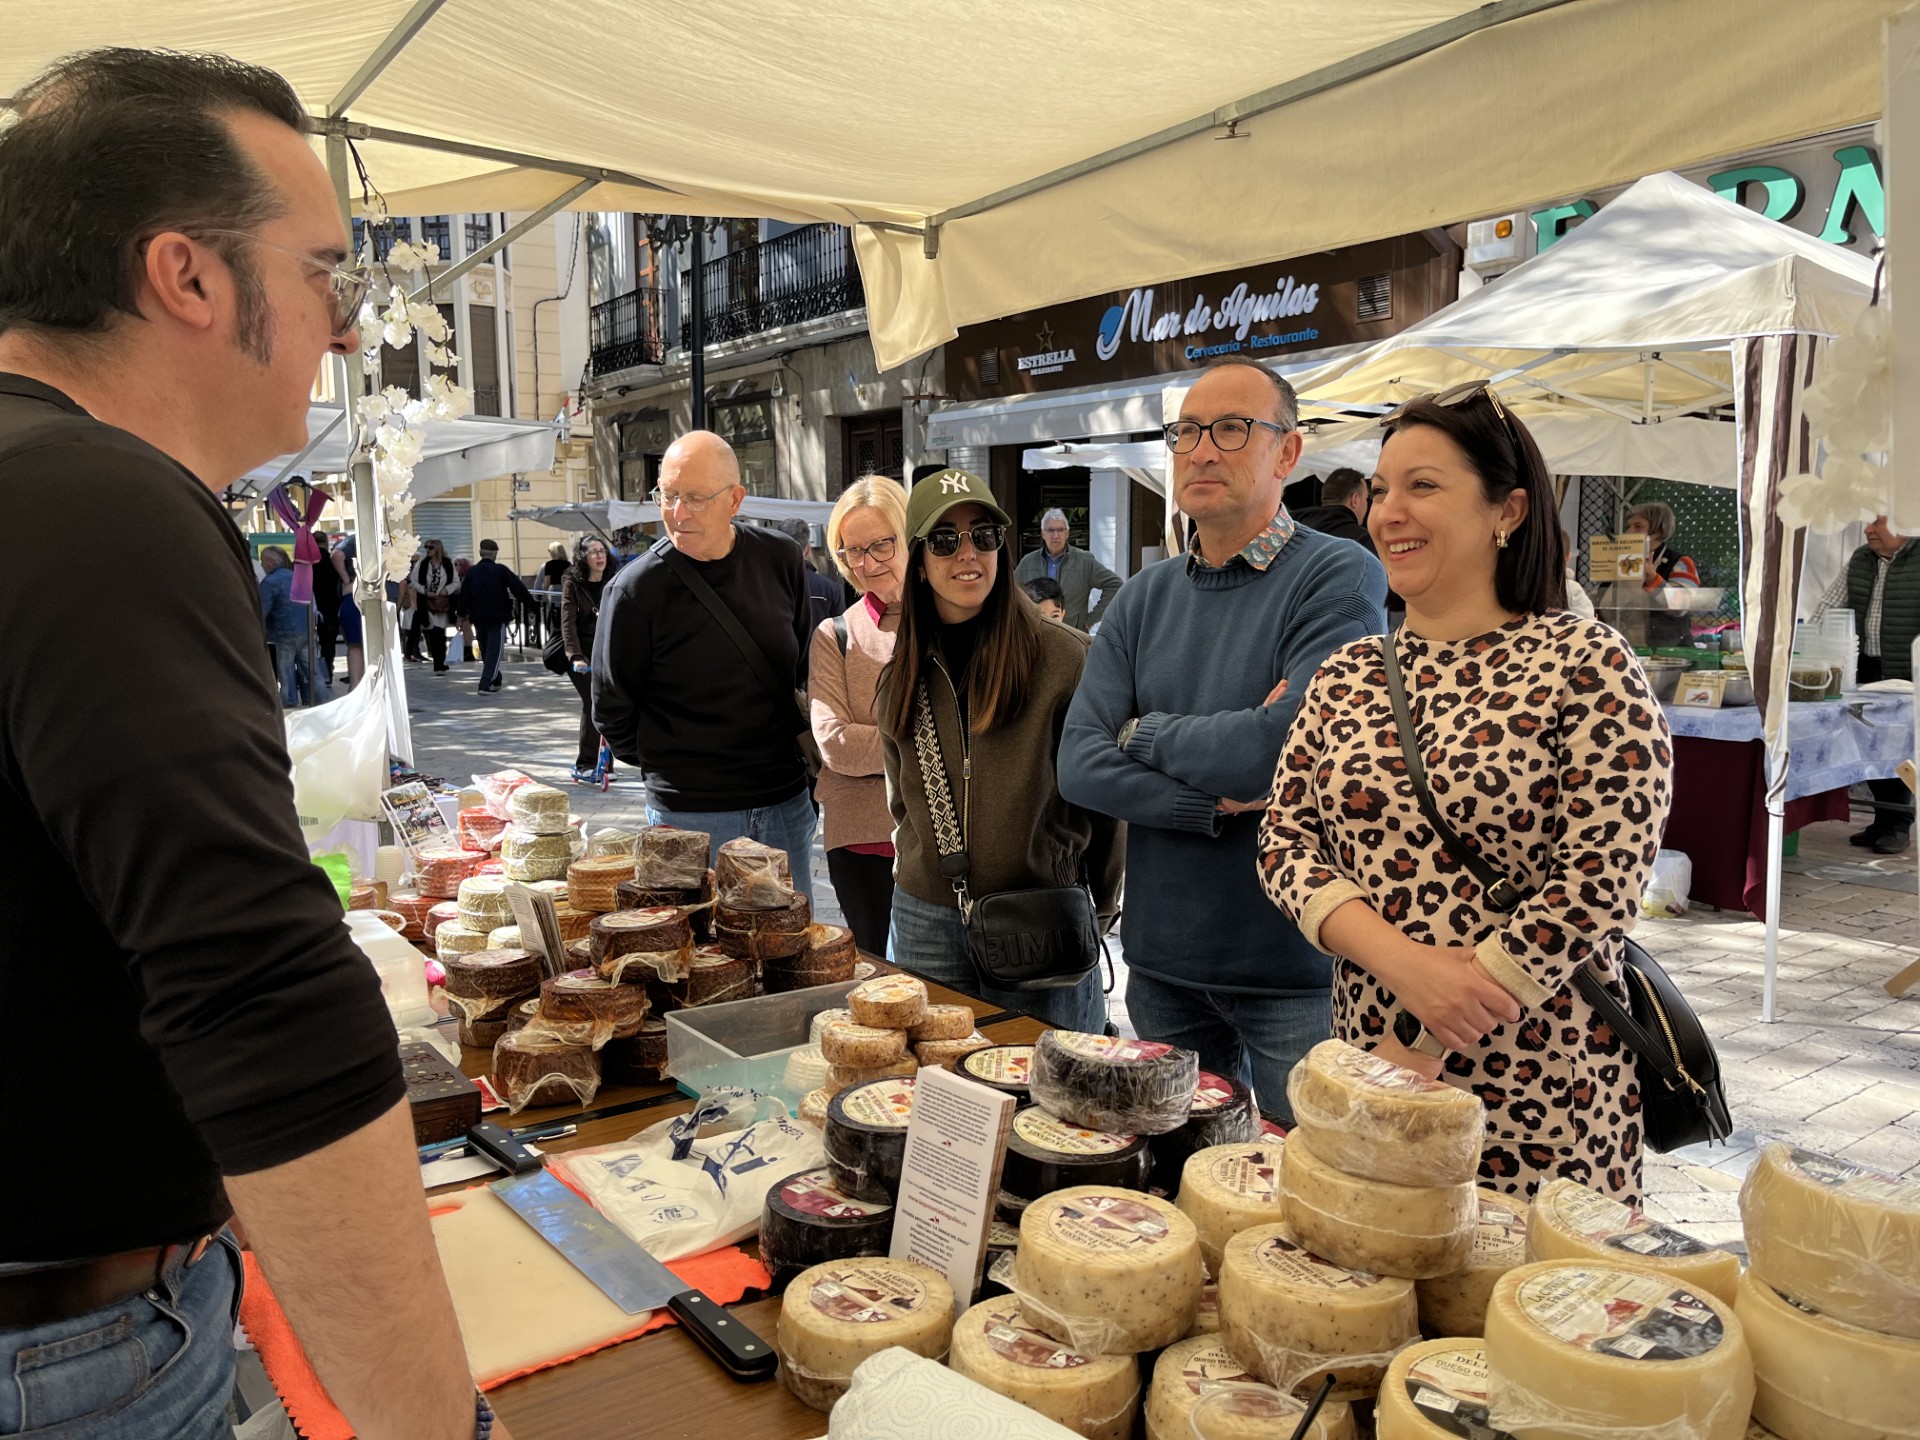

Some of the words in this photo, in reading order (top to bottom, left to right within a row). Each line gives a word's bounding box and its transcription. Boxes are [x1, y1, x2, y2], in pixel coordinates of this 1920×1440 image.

[1099, 288, 1181, 354] Mar
[1184, 294, 1212, 335] de
[1213, 275, 1319, 341] Aguilas
[1185, 338, 1241, 360] Cervecería
[1251, 327, 1318, 348] Restaurante
[1018, 349, 1076, 370] ESTRELLA
[1436, 1360, 1471, 1373] QUESO
[1456, 1356, 1481, 1367] DEL
